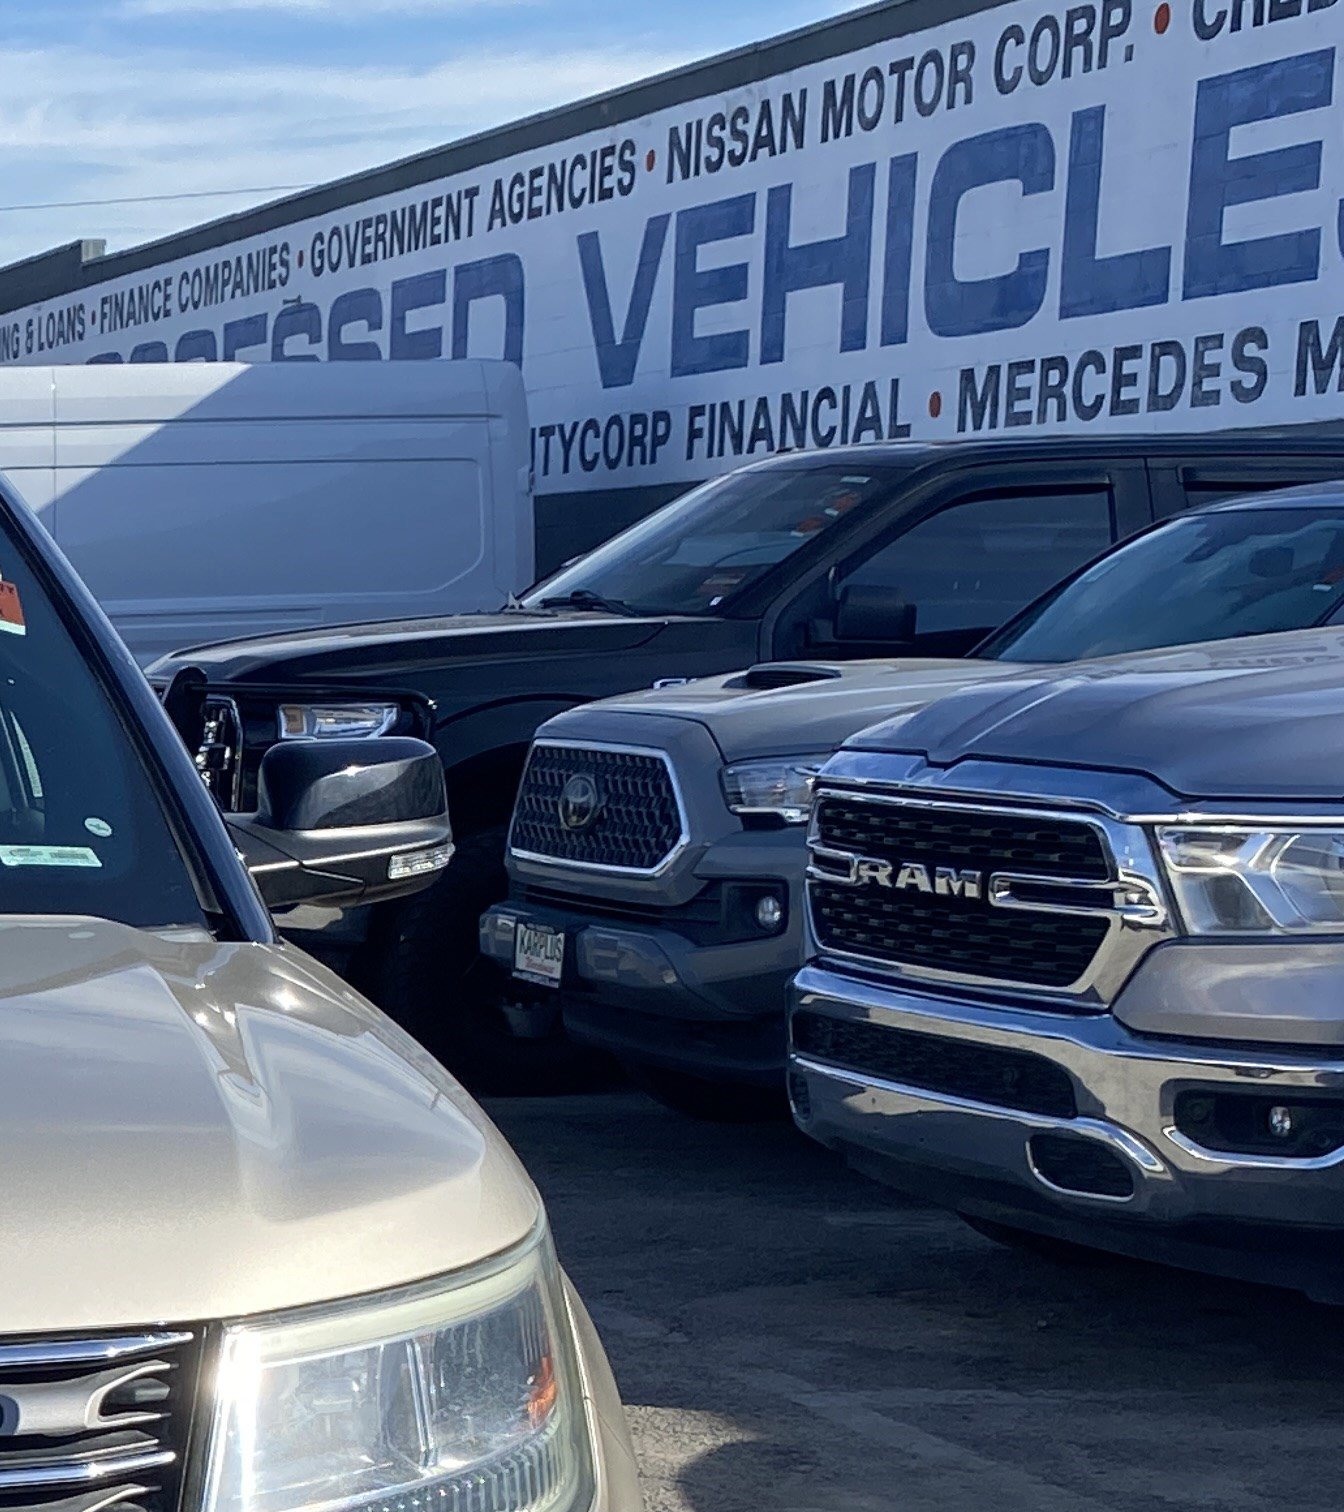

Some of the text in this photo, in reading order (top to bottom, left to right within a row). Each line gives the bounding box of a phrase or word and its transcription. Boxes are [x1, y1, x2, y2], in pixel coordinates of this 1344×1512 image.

[25, 317, 34, 355] &
[37, 302, 86, 352] LOANS
[99, 276, 173, 335] FINANCE
[178, 240, 291, 314] COMPANIES
[311, 184, 481, 278] GOVERNMENT
[487, 138, 638, 230] AGENCIES
[665, 87, 808, 185] NISSAN
[819, 39, 976, 144] MOTOR
[994, 3, 1135, 96] CORP.
[576, 45, 1344, 390] VEHICLE
[685, 377, 912, 461] FINANCIAL
[956, 325, 1270, 434] MERCEDES
[858, 857, 982, 899] RAM
